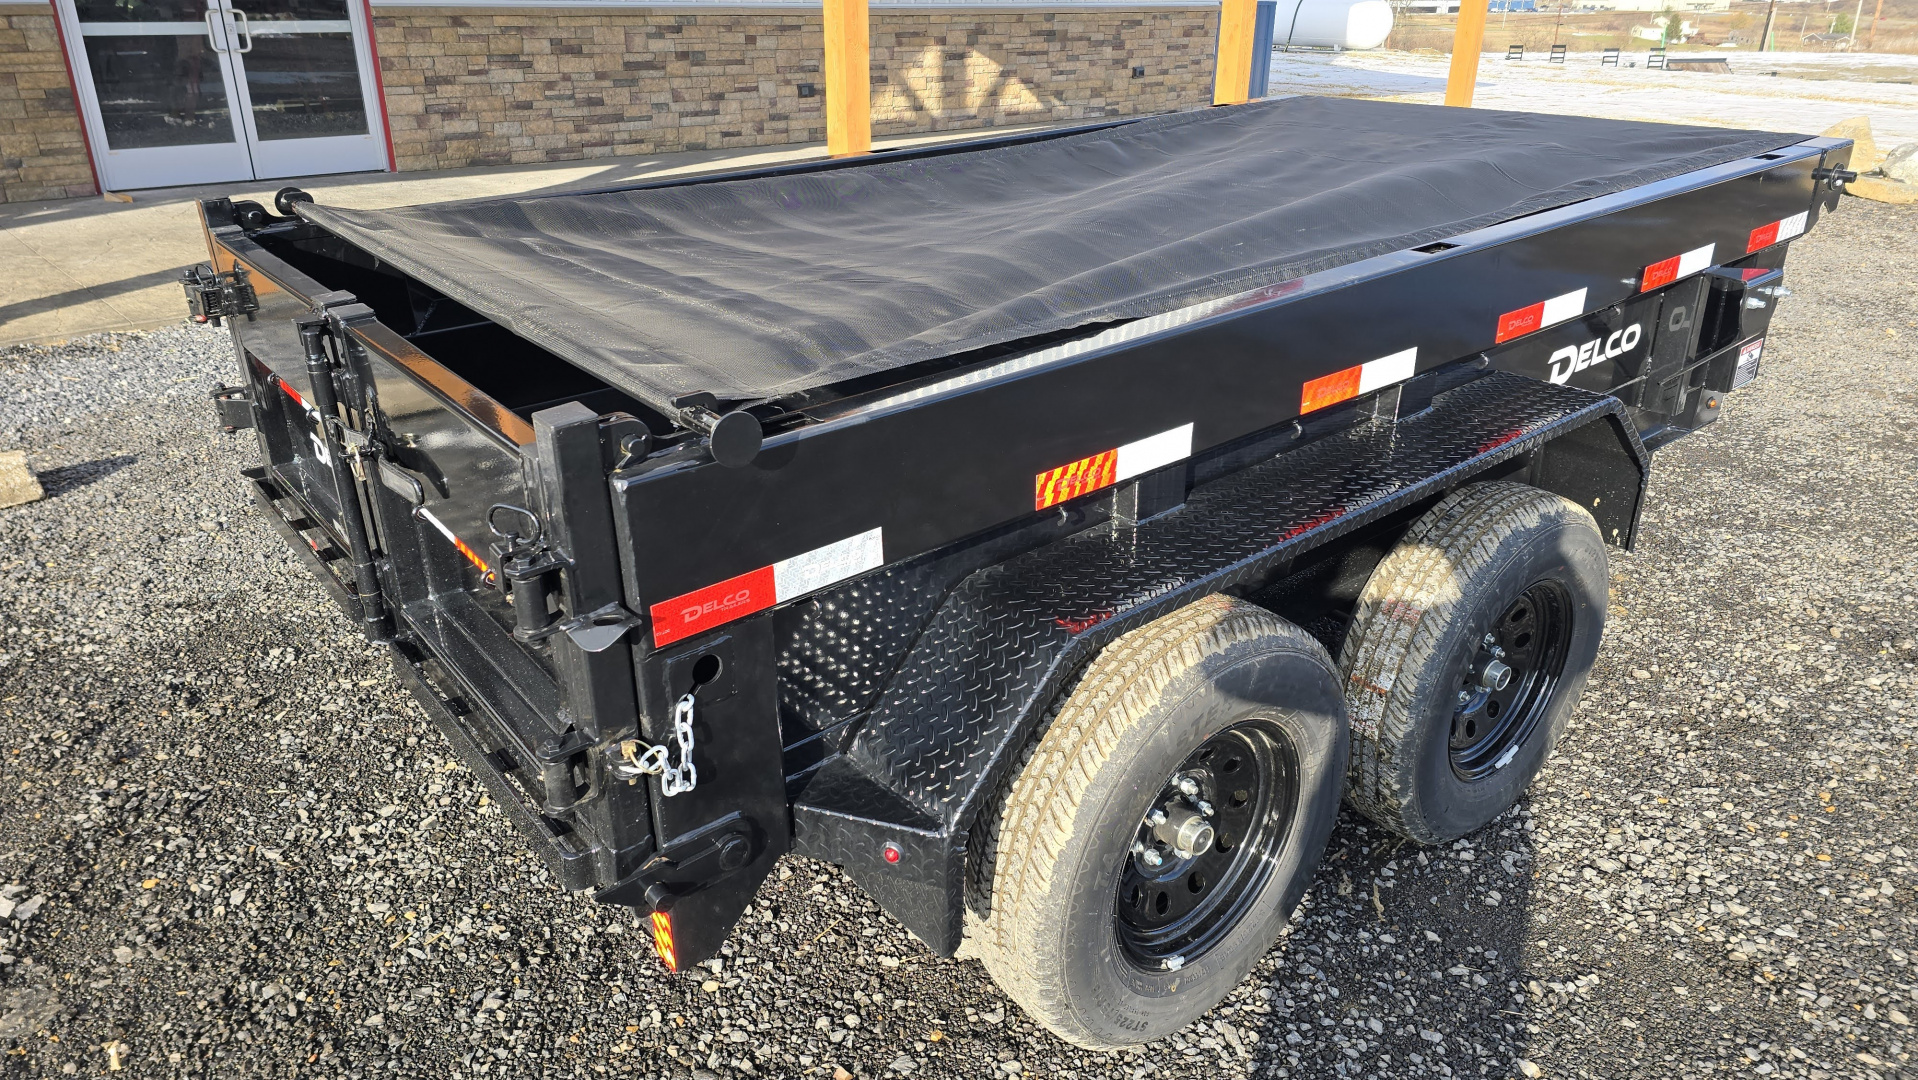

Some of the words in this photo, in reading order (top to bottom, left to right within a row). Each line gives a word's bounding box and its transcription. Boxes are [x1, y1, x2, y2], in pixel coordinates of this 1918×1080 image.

[1508, 315, 1534, 331] DELCO
[1547, 323, 1642, 386] DELCO
[1056, 467, 1102, 491] DELCO
[680, 589, 750, 624] DELCO
